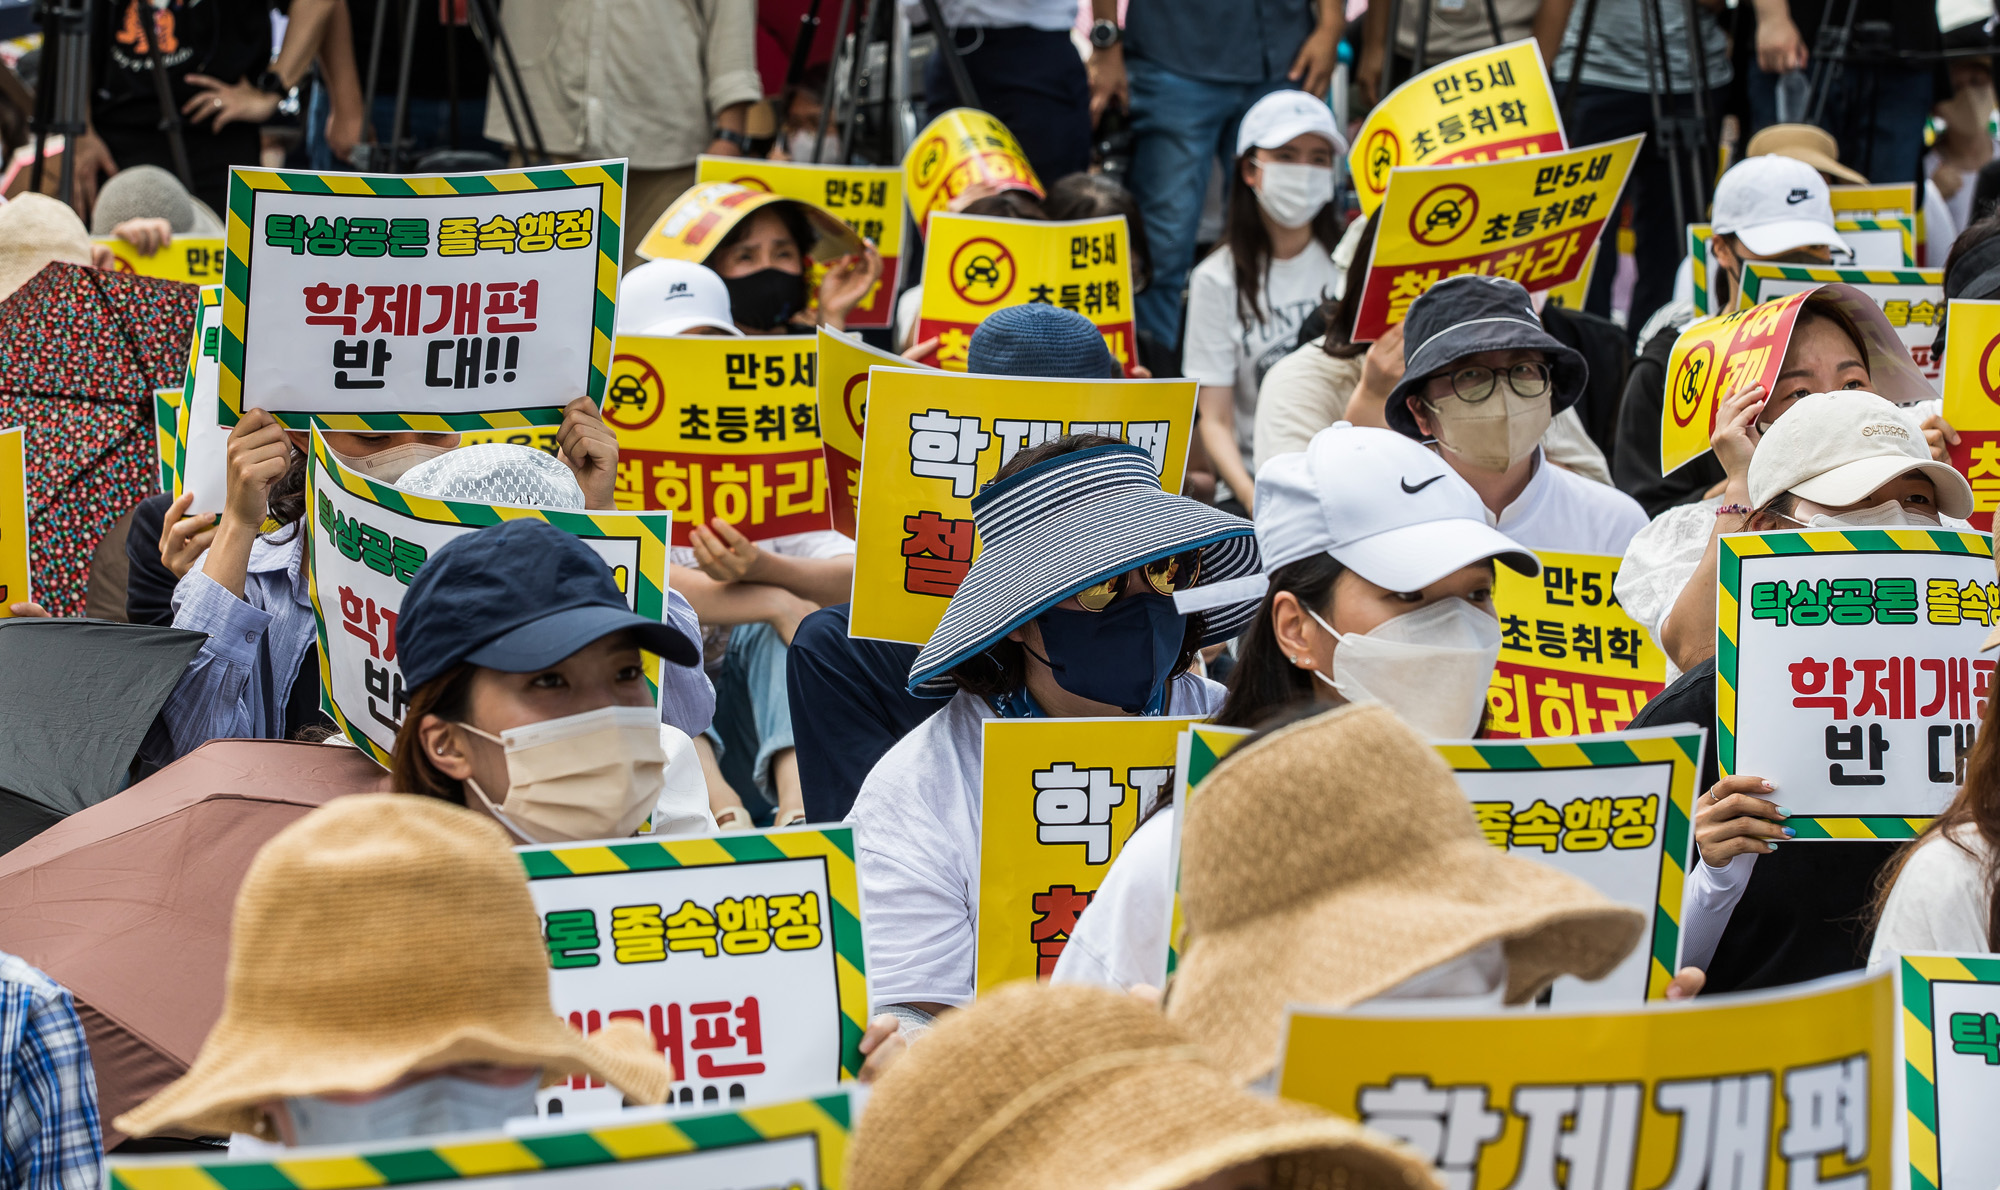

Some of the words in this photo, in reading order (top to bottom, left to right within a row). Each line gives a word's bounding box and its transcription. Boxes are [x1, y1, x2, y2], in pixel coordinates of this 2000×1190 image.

[1433, 60, 1515, 105] 만5세
[1410, 99, 1528, 162] 초등취학
[825, 178, 887, 208] 만5세
[1534, 153, 1613, 197] 만5세
[265, 214, 430, 258] 탁상공론
[437, 208, 594, 257] 졸속행정
[1480, 193, 1597, 244] 초등취학
[1071, 233, 1117, 269] 만5세
[303, 278, 540, 336] 학제개편
[333, 338, 393, 390] 반
[725, 352, 817, 390] 만5세
[680, 403, 821, 443] 초등취학
[318, 488, 428, 586] 탁상공론
[1751, 577, 1918, 627] 탁상공론
[1500, 614, 1642, 669] 초등취학
[1825, 723, 1890, 786] 반
[1472, 793, 1660, 853] 졸속행정
[611, 891, 822, 965] 졸속행정
